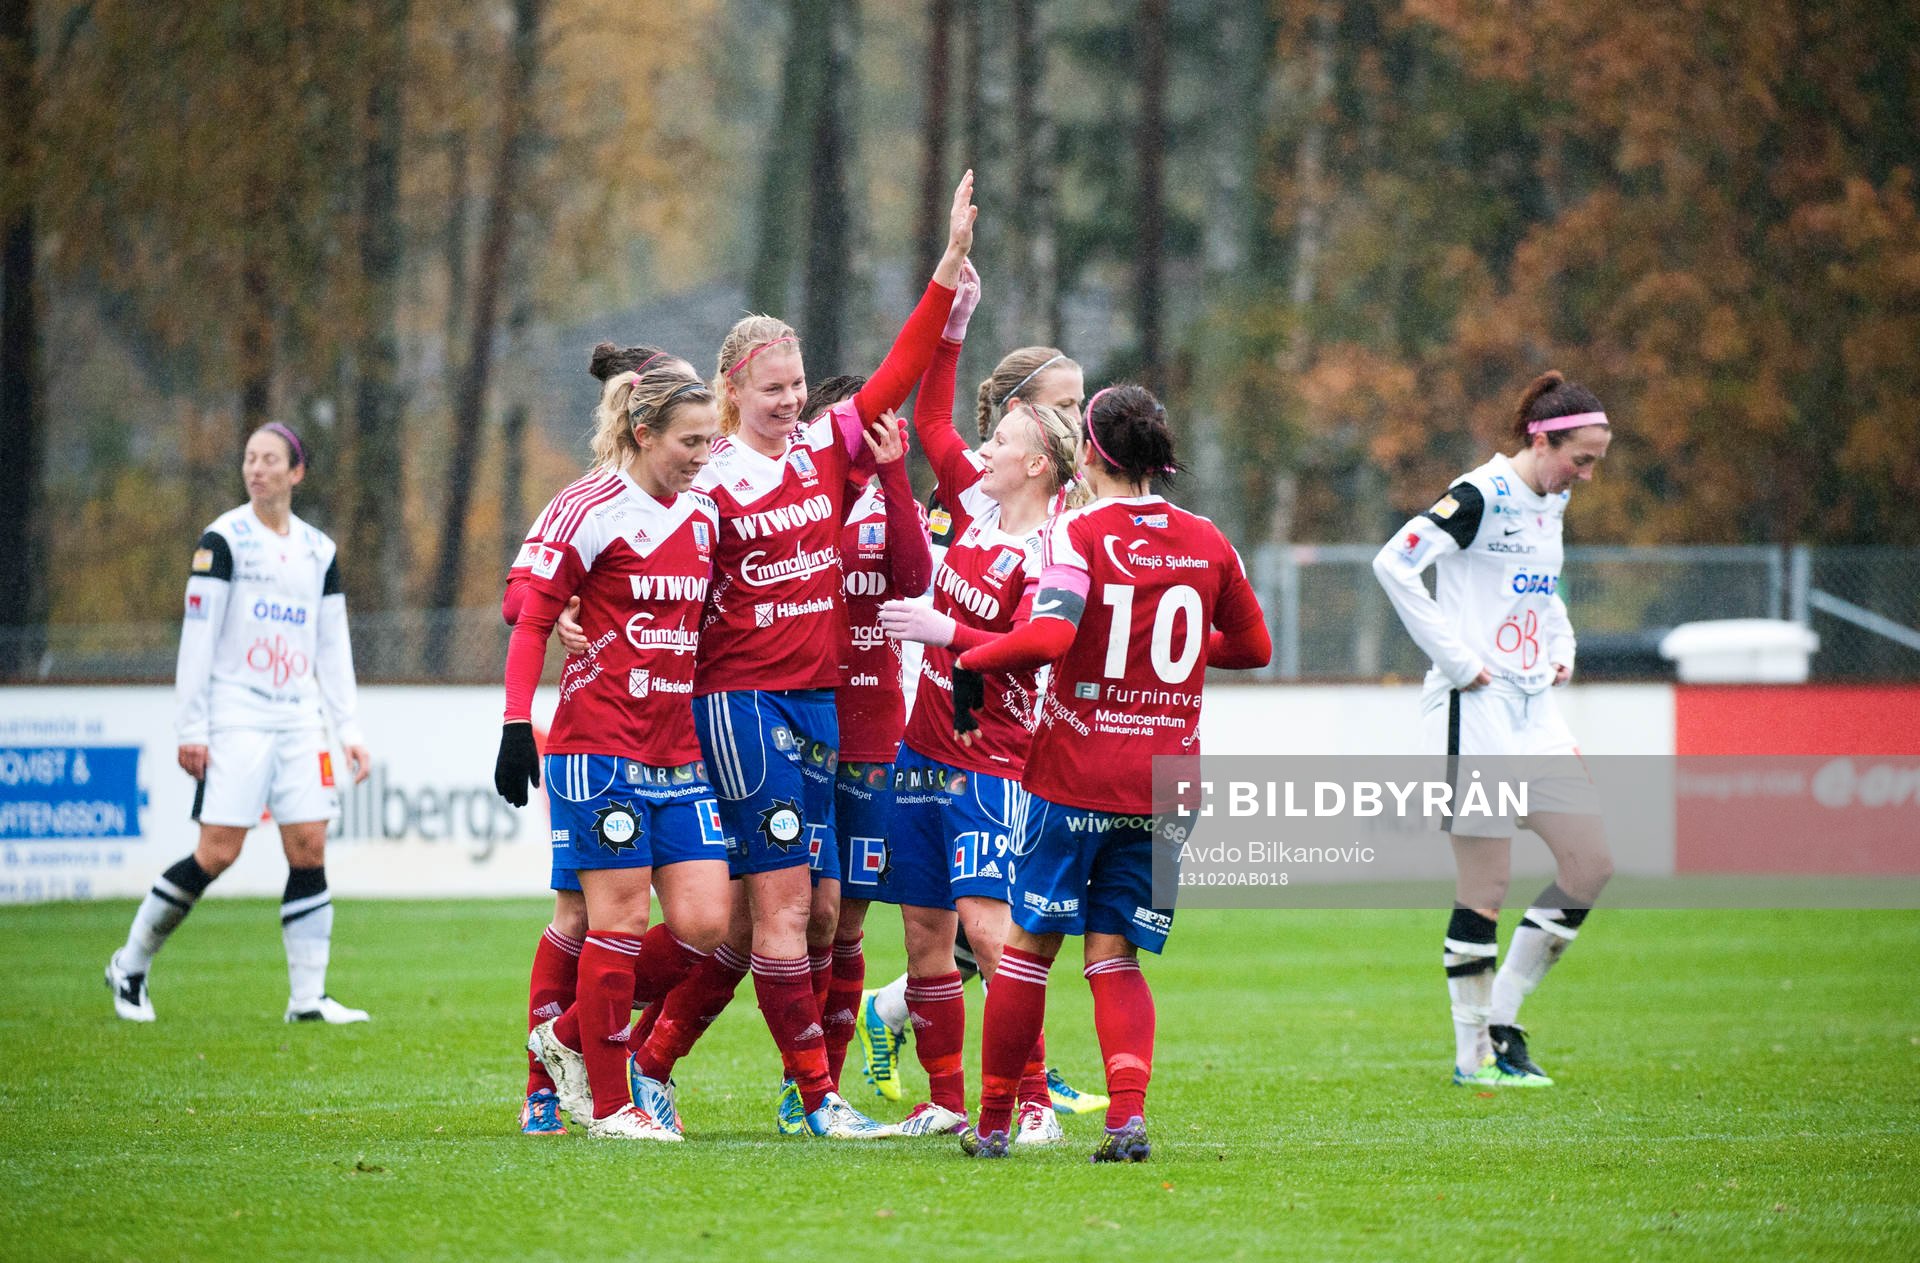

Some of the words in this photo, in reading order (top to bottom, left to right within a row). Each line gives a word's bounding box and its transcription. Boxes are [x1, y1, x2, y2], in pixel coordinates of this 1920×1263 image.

[731, 493, 833, 541] WIWOOD
[1128, 552, 1162, 569] Vittsjö
[1165, 555, 1208, 570] Sjukhem
[1103, 583, 1203, 684] 10
[1095, 708, 1186, 729] Motorcentrum
[1100, 724, 1137, 736] Markaryd
[1140, 727, 1154, 736] AB
[605, 818, 632, 832] SFA
[772, 816, 798, 832] SFA
[980, 832, 1009, 858] 19
